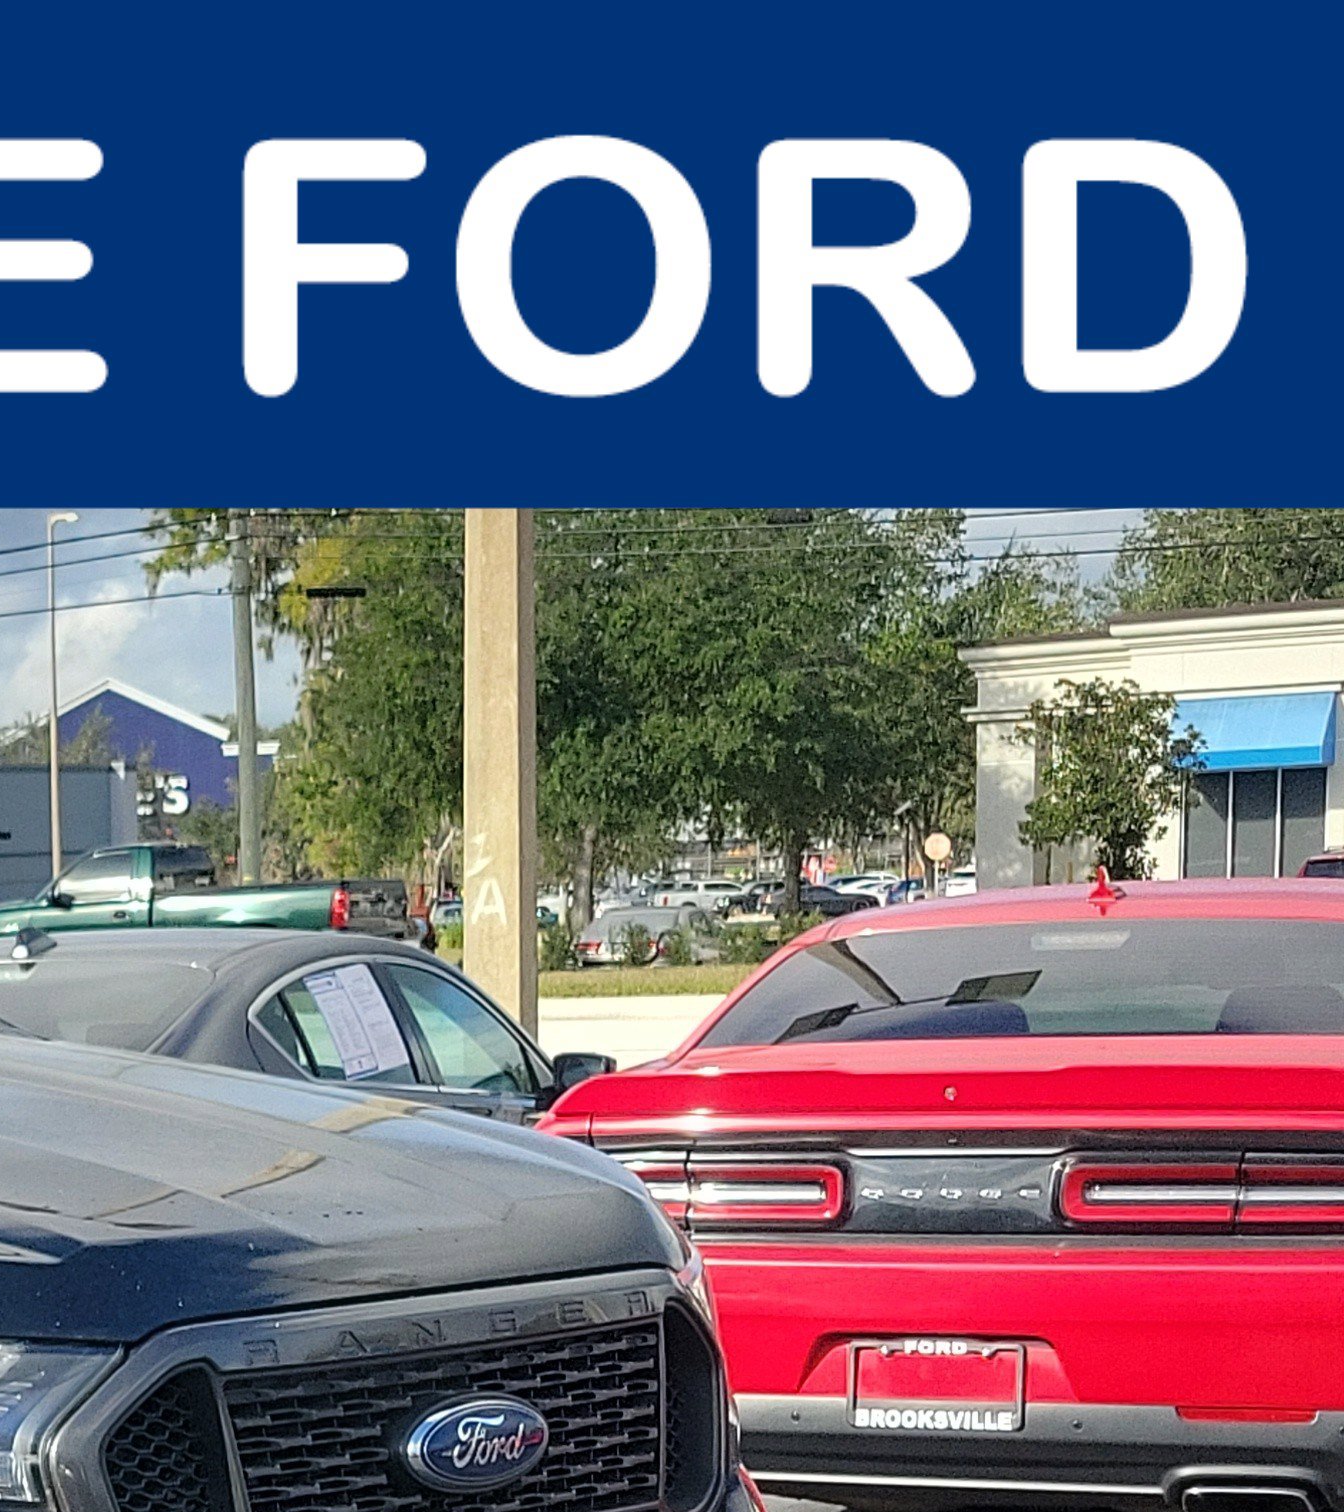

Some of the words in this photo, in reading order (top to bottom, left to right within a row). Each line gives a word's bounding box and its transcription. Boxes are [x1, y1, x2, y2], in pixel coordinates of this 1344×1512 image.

[242, 1290, 655, 1367] RANGER
[903, 1340, 968, 1355] FORD
[854, 1407, 1014, 1432] BROOKSVILLE
[453, 1413, 525, 1468] Ford
